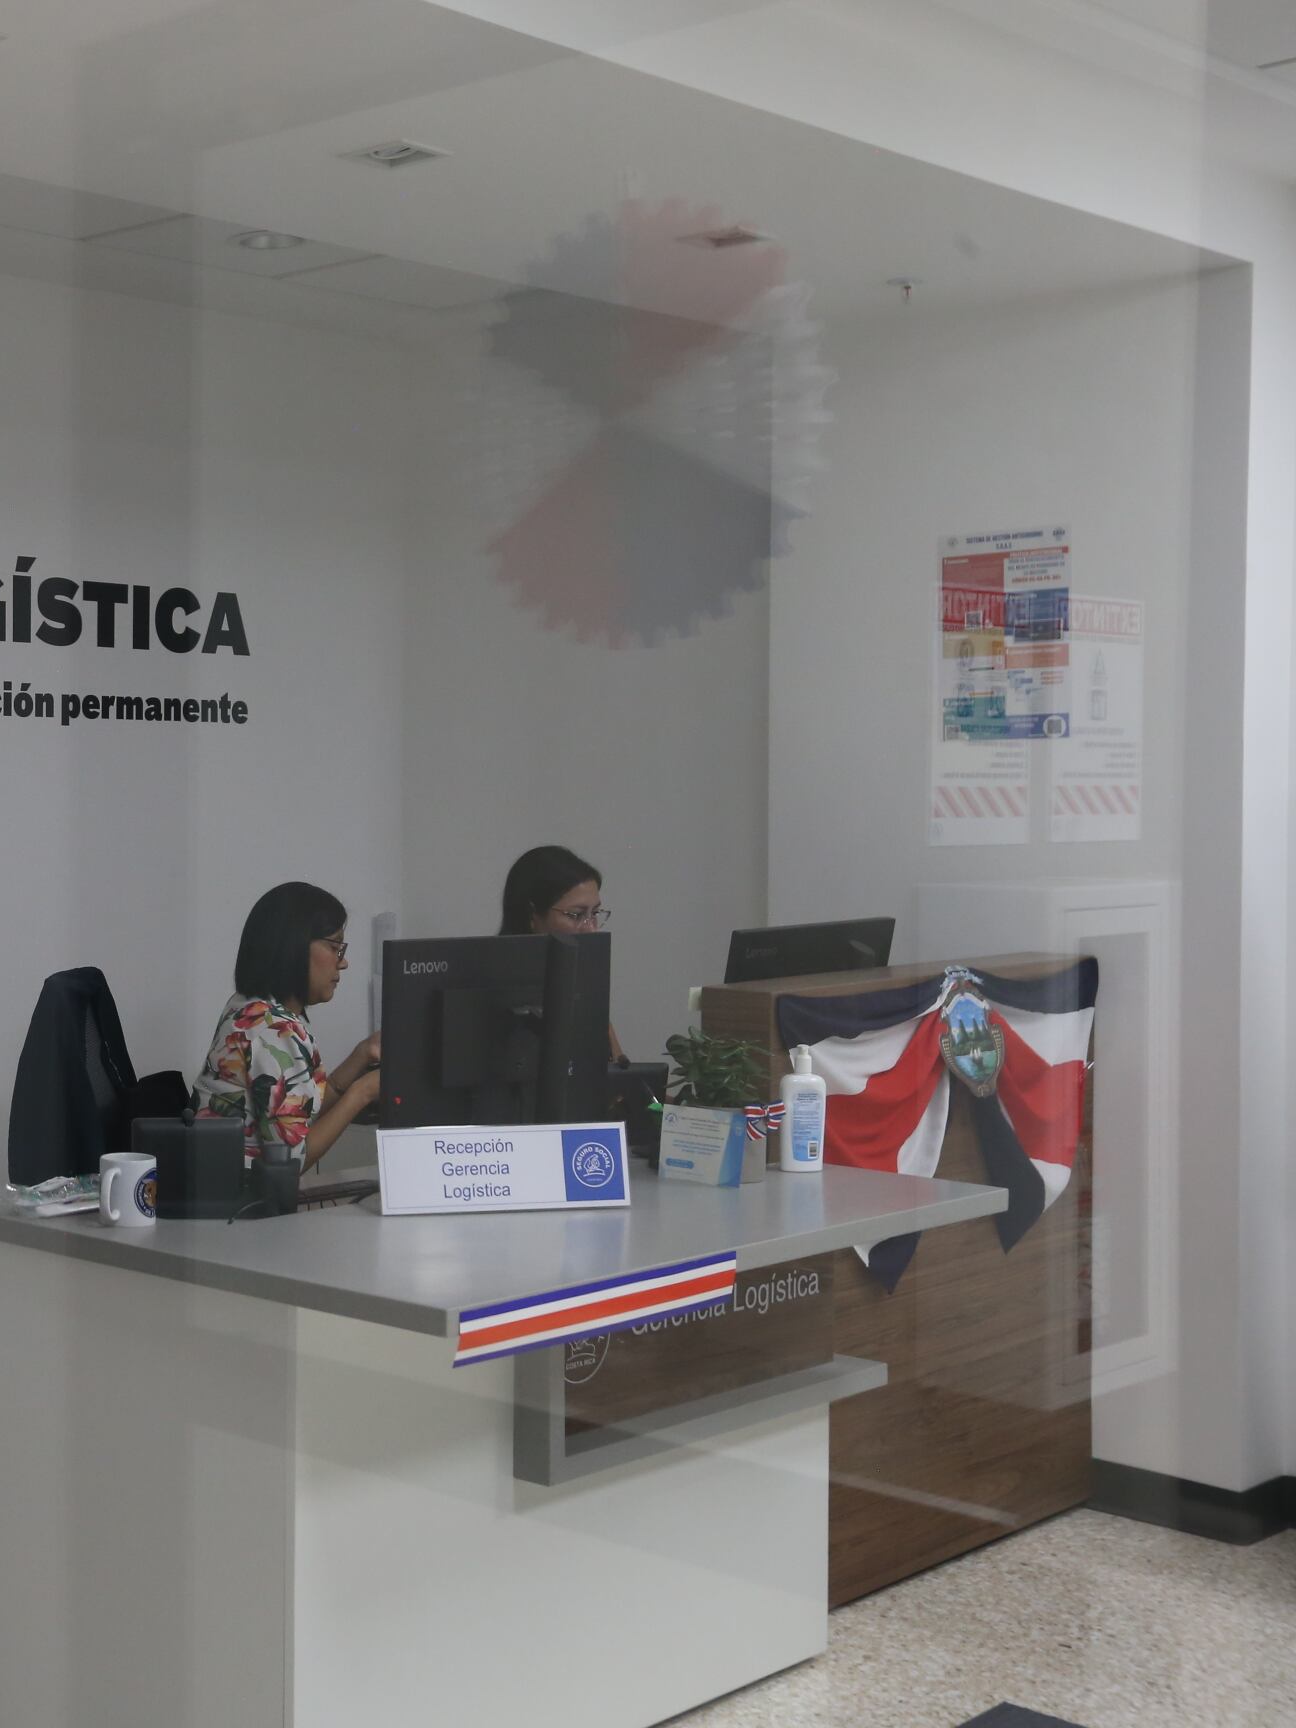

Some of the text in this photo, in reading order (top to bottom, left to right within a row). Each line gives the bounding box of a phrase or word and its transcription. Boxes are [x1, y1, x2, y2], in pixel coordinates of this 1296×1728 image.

[60, 692, 249, 727] permanente
[403, 959, 449, 975] Lenovo
[434, 1138, 514, 1157] Recepción
[442, 1160, 510, 1177] Gerencia
[576, 1146, 611, 1171] SEGURO SOCIAL
[444, 1181, 511, 1202] Logística
[732, 1270, 821, 1314] Logística
